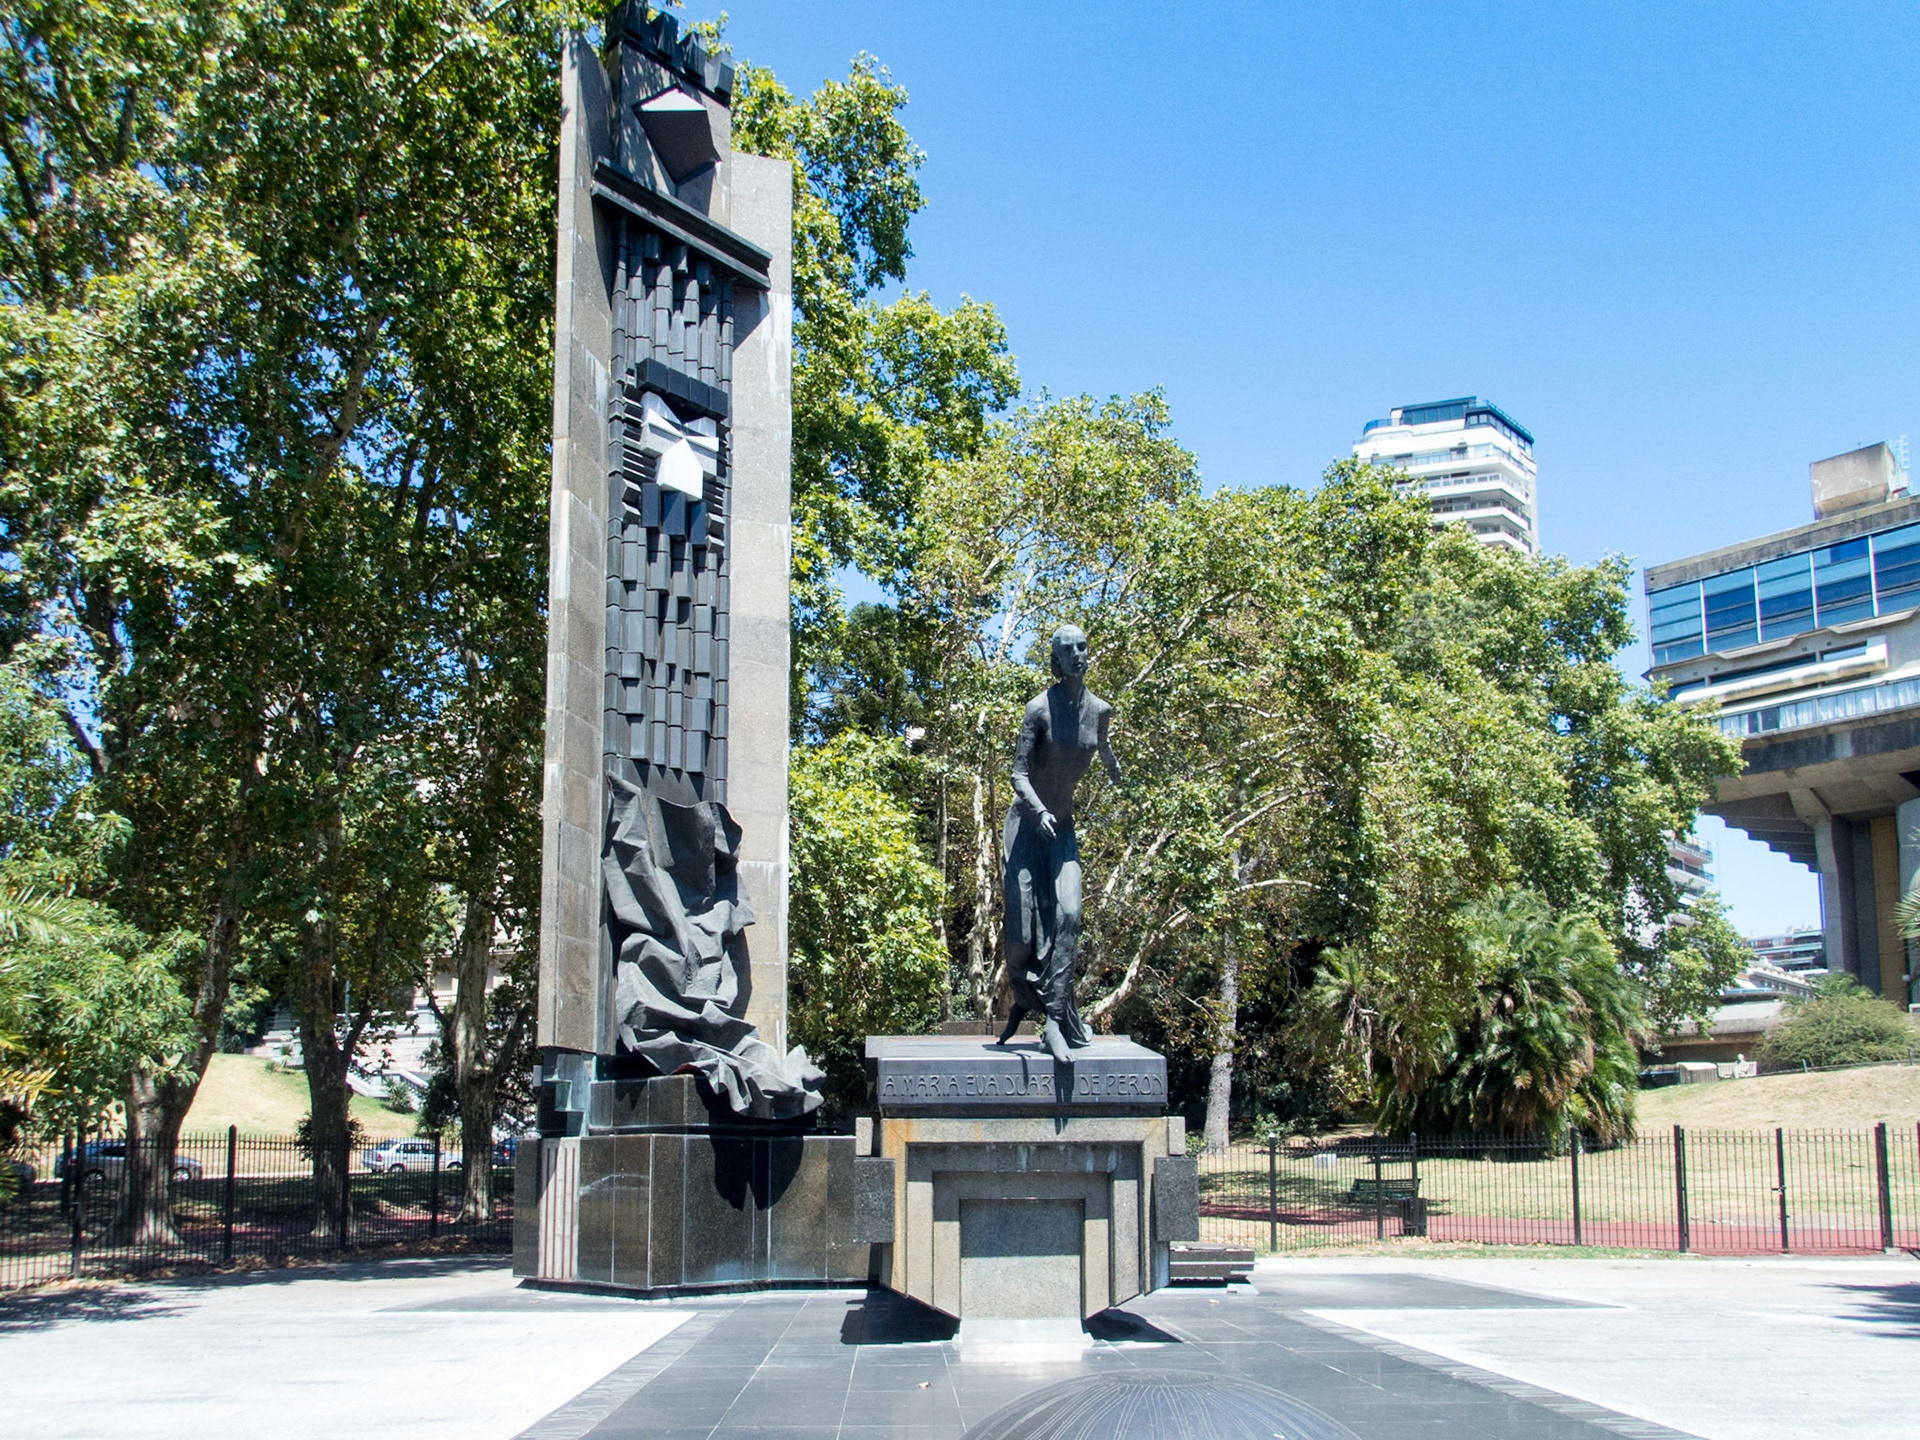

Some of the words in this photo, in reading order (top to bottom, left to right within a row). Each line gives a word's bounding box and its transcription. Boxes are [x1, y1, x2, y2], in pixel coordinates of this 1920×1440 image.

[882, 1075, 897, 1096] A
[900, 1075, 961, 1097] MARIA
[965, 1075, 1000, 1096] EVA
[1004, 1074, 1073, 1096] DUAR
[1079, 1074, 1101, 1096] DE
[1106, 1074, 1165, 1096] PERON
